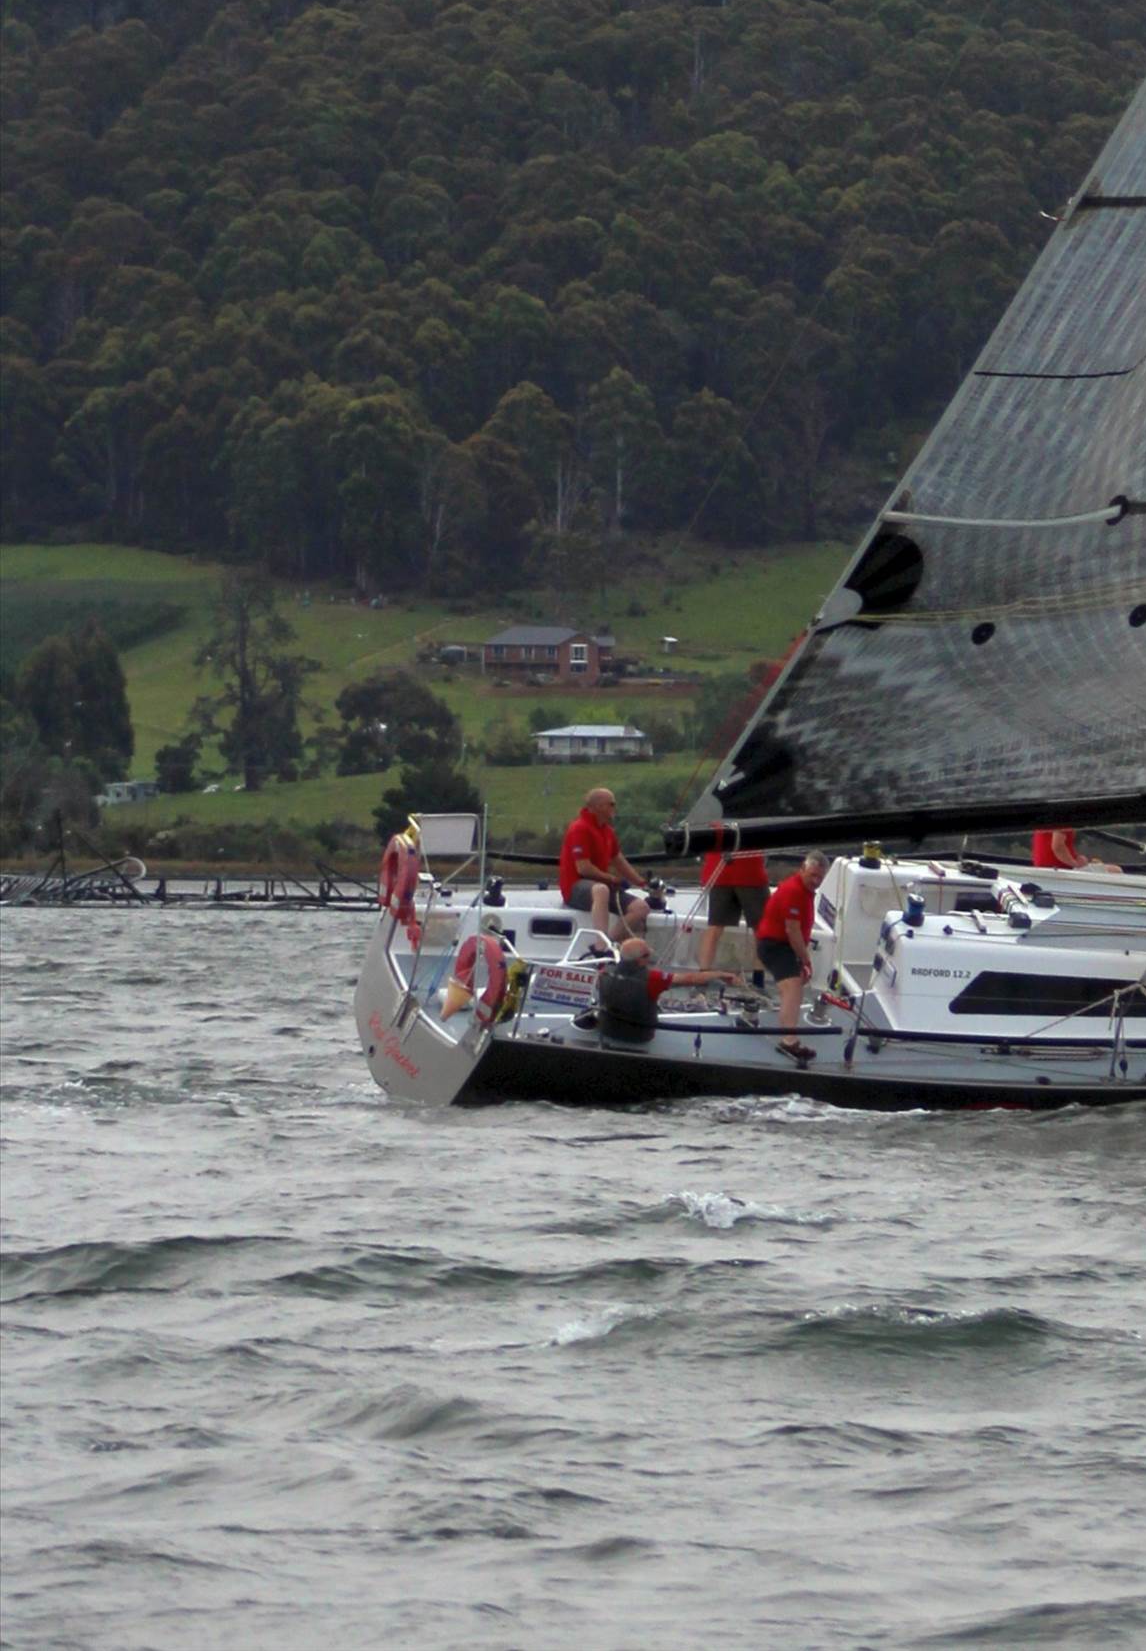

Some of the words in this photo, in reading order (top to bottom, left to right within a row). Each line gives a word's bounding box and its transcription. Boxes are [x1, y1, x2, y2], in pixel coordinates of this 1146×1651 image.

[540, 967, 562, 979] FOR
[566, 971, 594, 984] SALE
[911, 967, 951, 978] RADFORD
